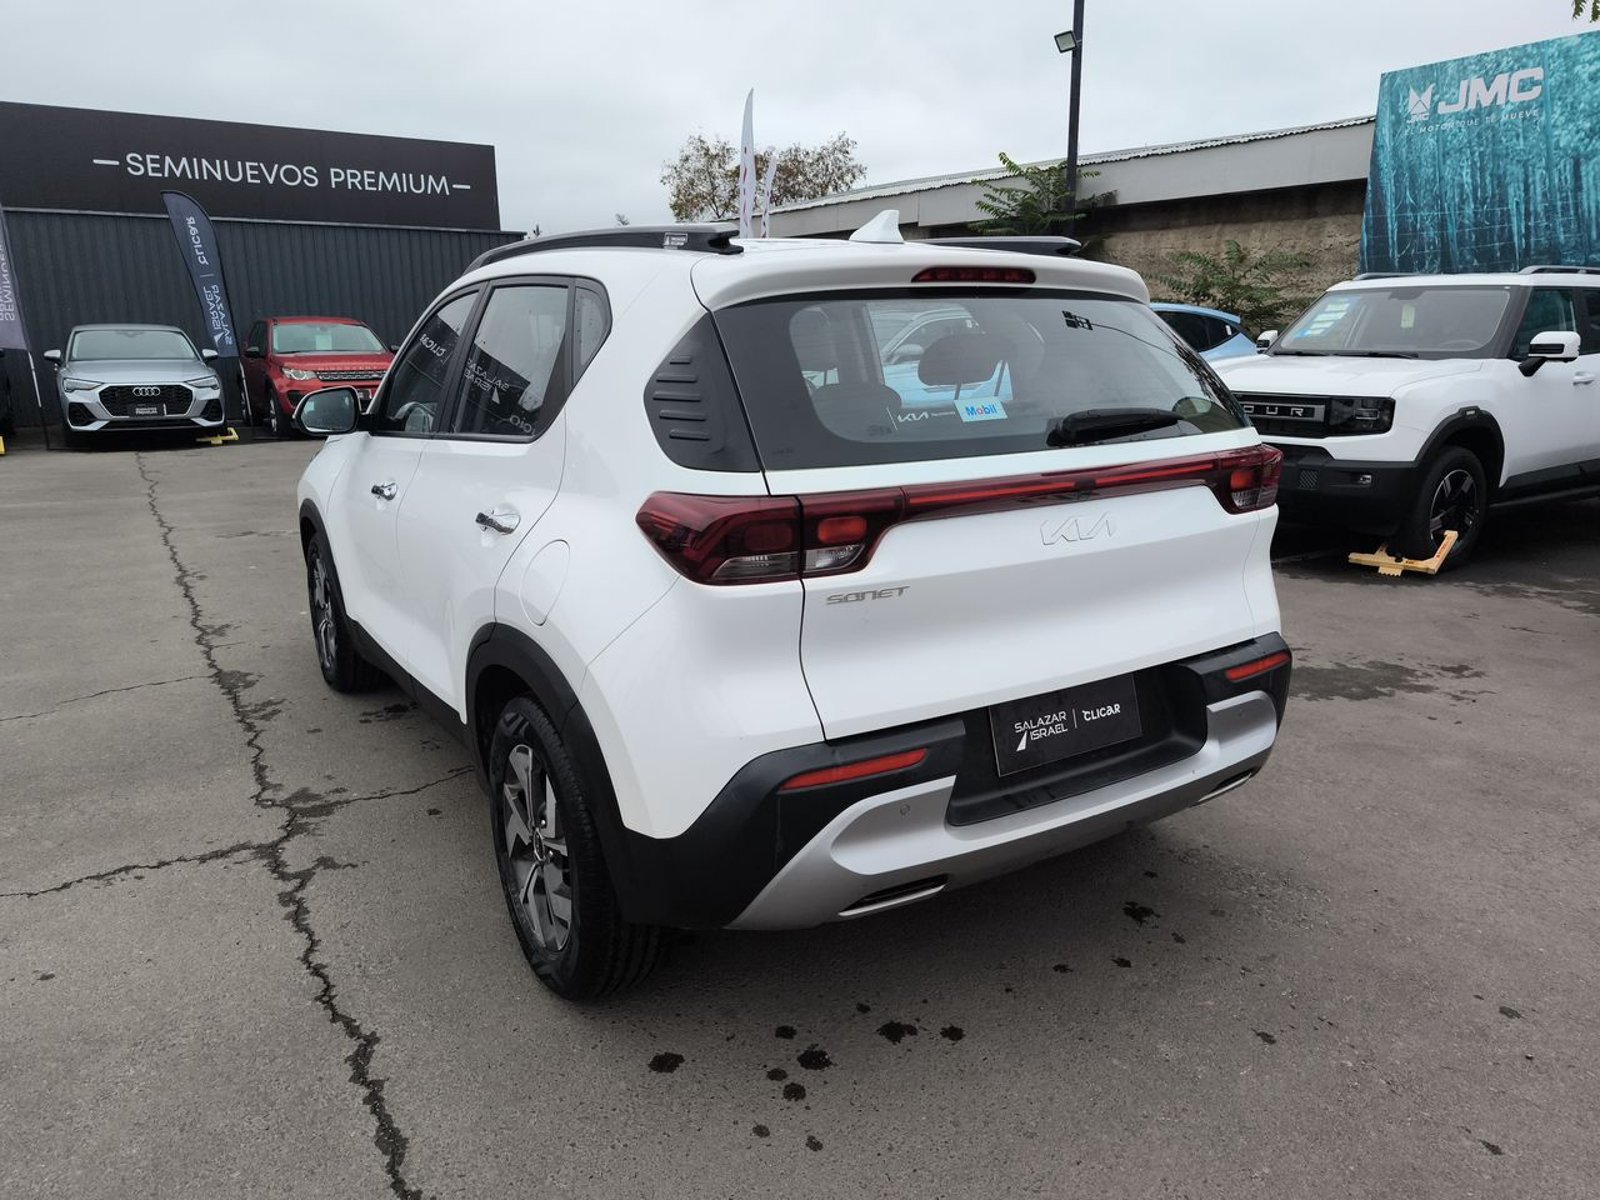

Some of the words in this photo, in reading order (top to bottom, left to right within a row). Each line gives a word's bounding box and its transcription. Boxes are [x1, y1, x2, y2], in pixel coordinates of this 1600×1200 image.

[1437, 66, 1544, 114] JMC
[126, 152, 319, 187] SEMINUEVOS
[330, 167, 450, 196] PREMIUM
[965, 404, 998, 417] Mobil
[1040, 510, 1117, 545] KIA
[1014, 711, 1067, 733] SALAZAR
[1030, 723, 1068, 741] ISRAEL
